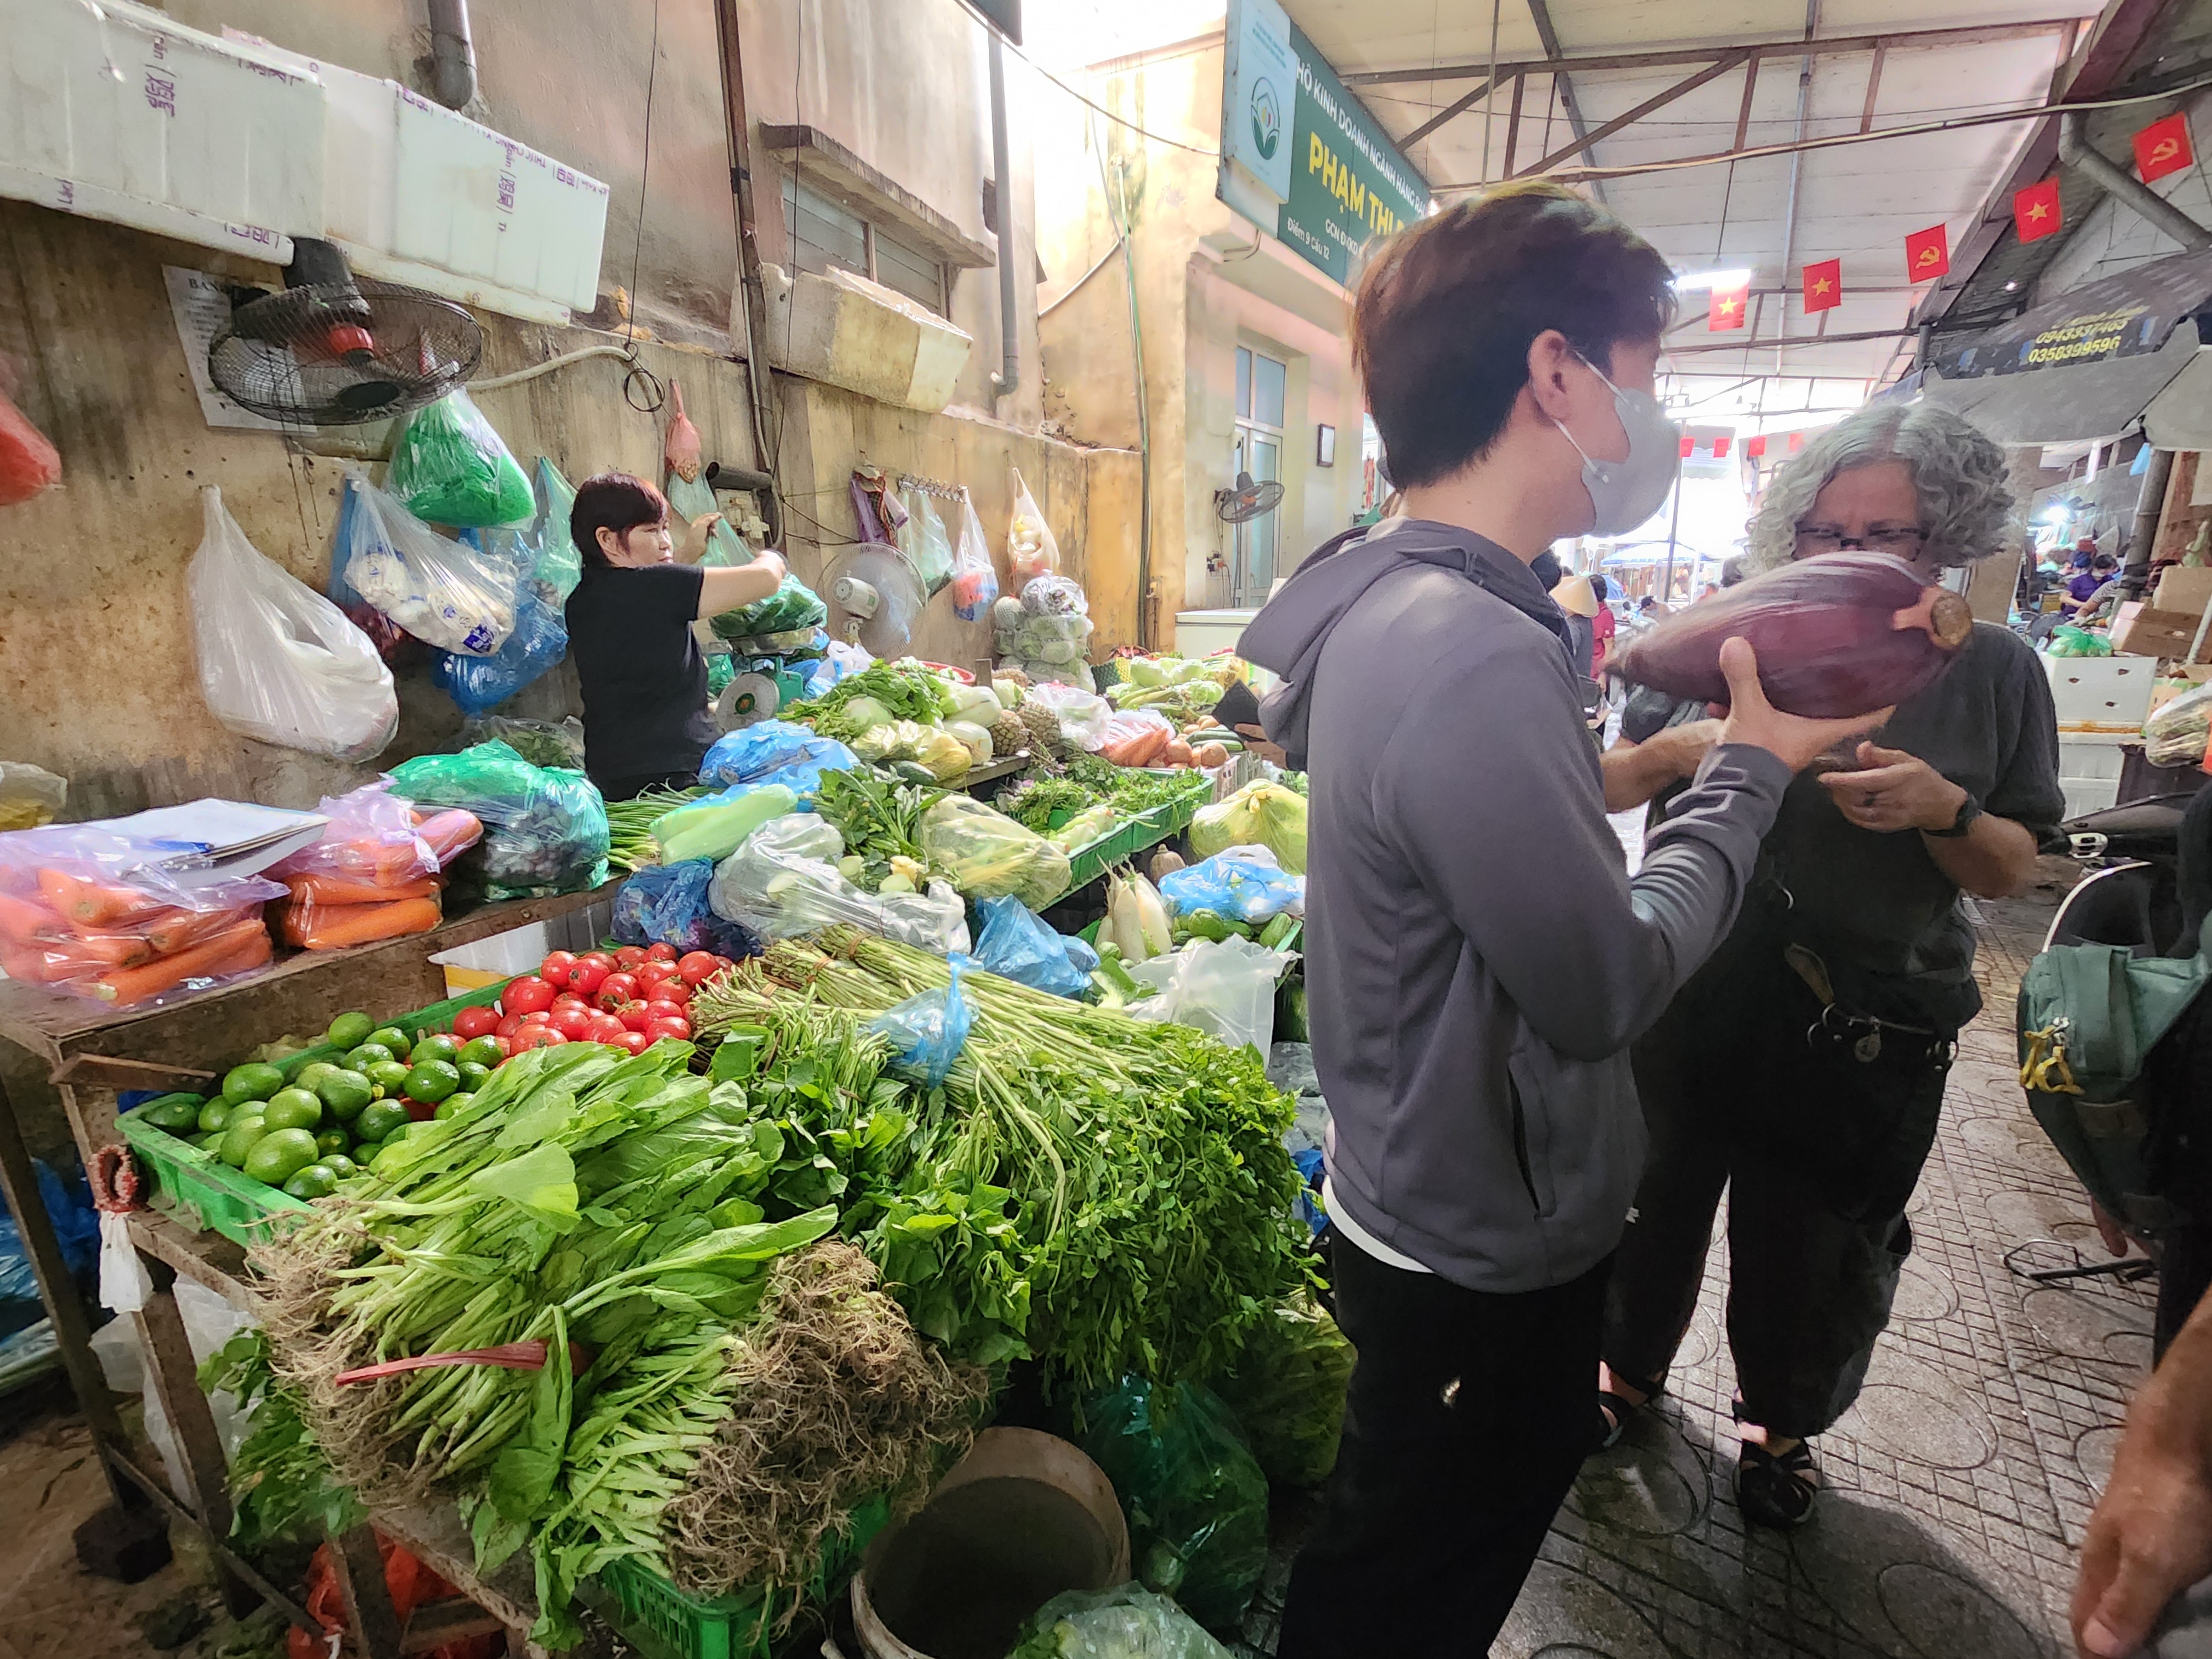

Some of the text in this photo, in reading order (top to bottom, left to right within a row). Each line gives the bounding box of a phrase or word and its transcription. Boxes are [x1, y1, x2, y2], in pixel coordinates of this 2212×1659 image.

[1309, 131, 1365, 219] PHẠM
[1313, 80, 1338, 122] KINH
[1338, 109, 1369, 156] DOANH
[1370, 143, 1397, 187] NGÀNH
[1396, 175, 1415, 210] HÀNG
[1306, 231, 1311, 246] 9
